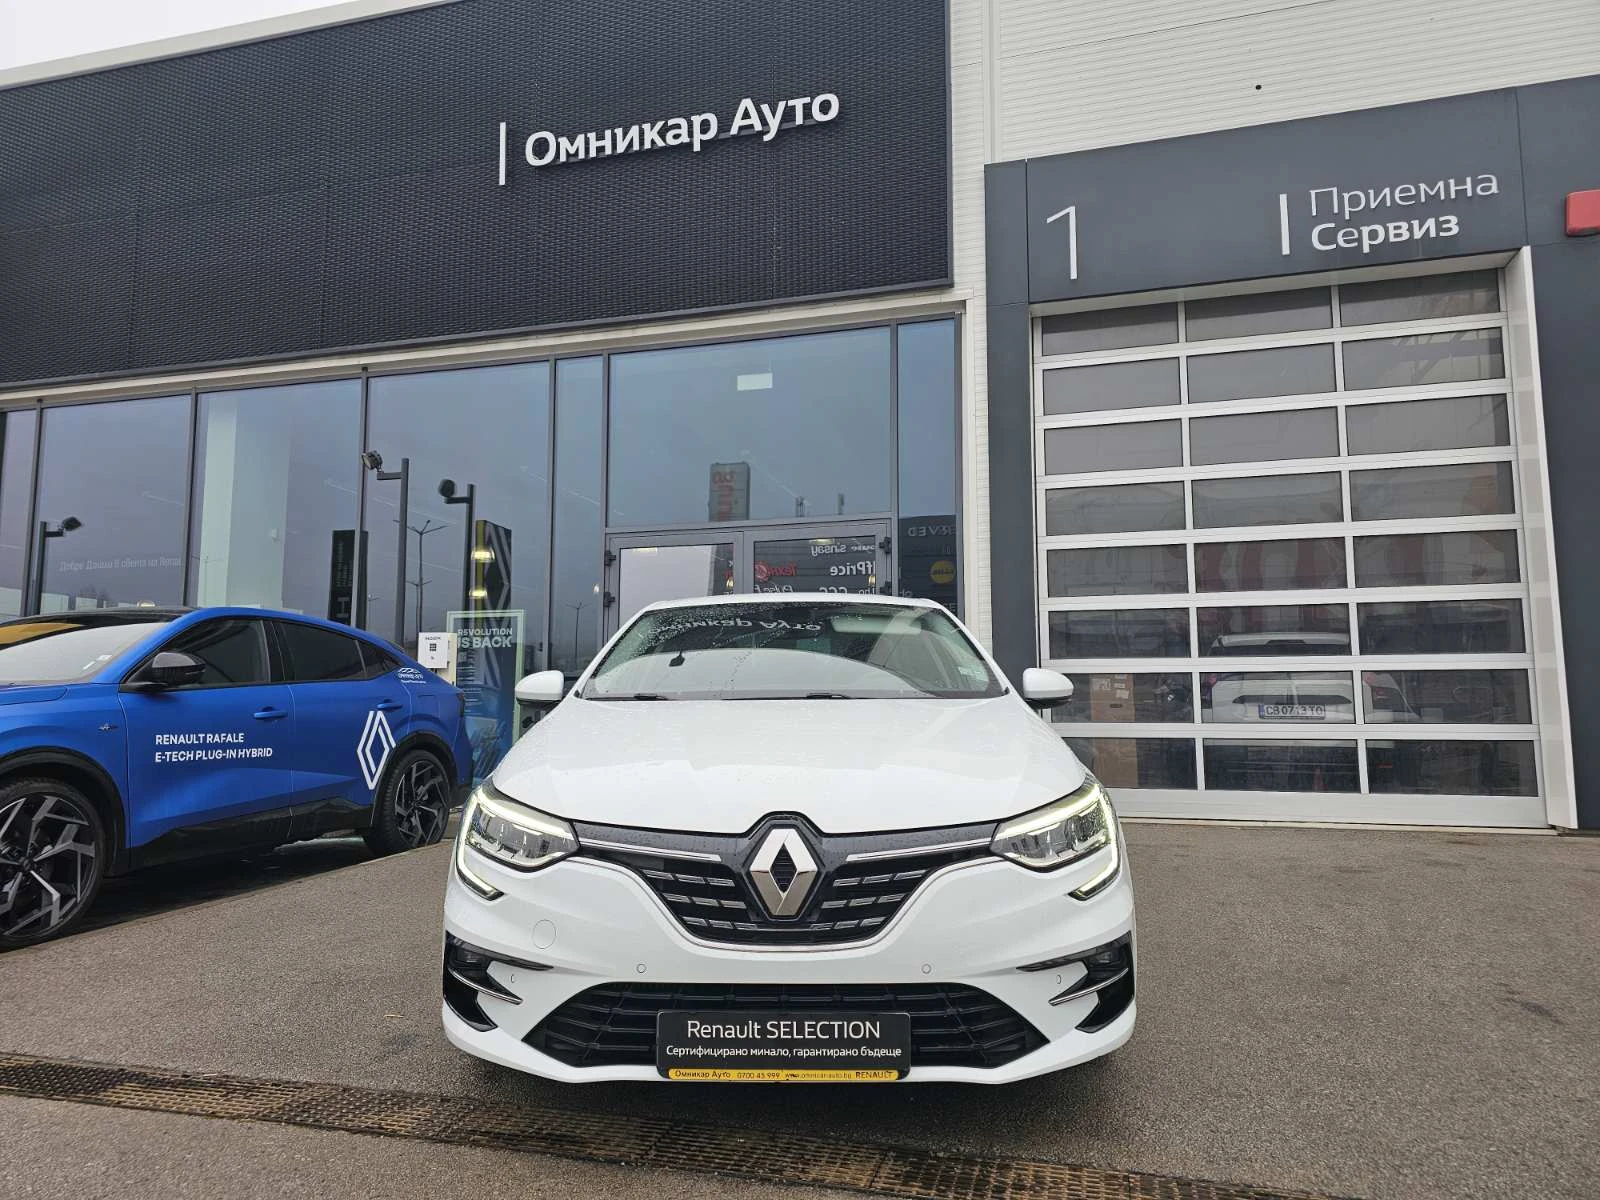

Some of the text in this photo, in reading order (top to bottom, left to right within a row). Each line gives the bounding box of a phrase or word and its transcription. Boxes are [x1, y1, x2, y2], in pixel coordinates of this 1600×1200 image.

[525, 93, 840, 167] Омникар Ауто
[1309, 173, 1499, 220] Приемна
[1046, 205, 1077, 280] 1
[1311, 215, 1460, 253] Сервиз
[473, 636, 512, 648] BACK
[155, 733, 245, 745] RENAULT RAFALE
[155, 747, 273, 762] E-TECH PLUG-IN HYBRID
[687, 1020, 881, 1039] Renault SELECTION
[666, 1045, 902, 1058] Сертифицирано минало, гарантирано бъдеще
[855, 1071, 894, 1079] RENAULT
